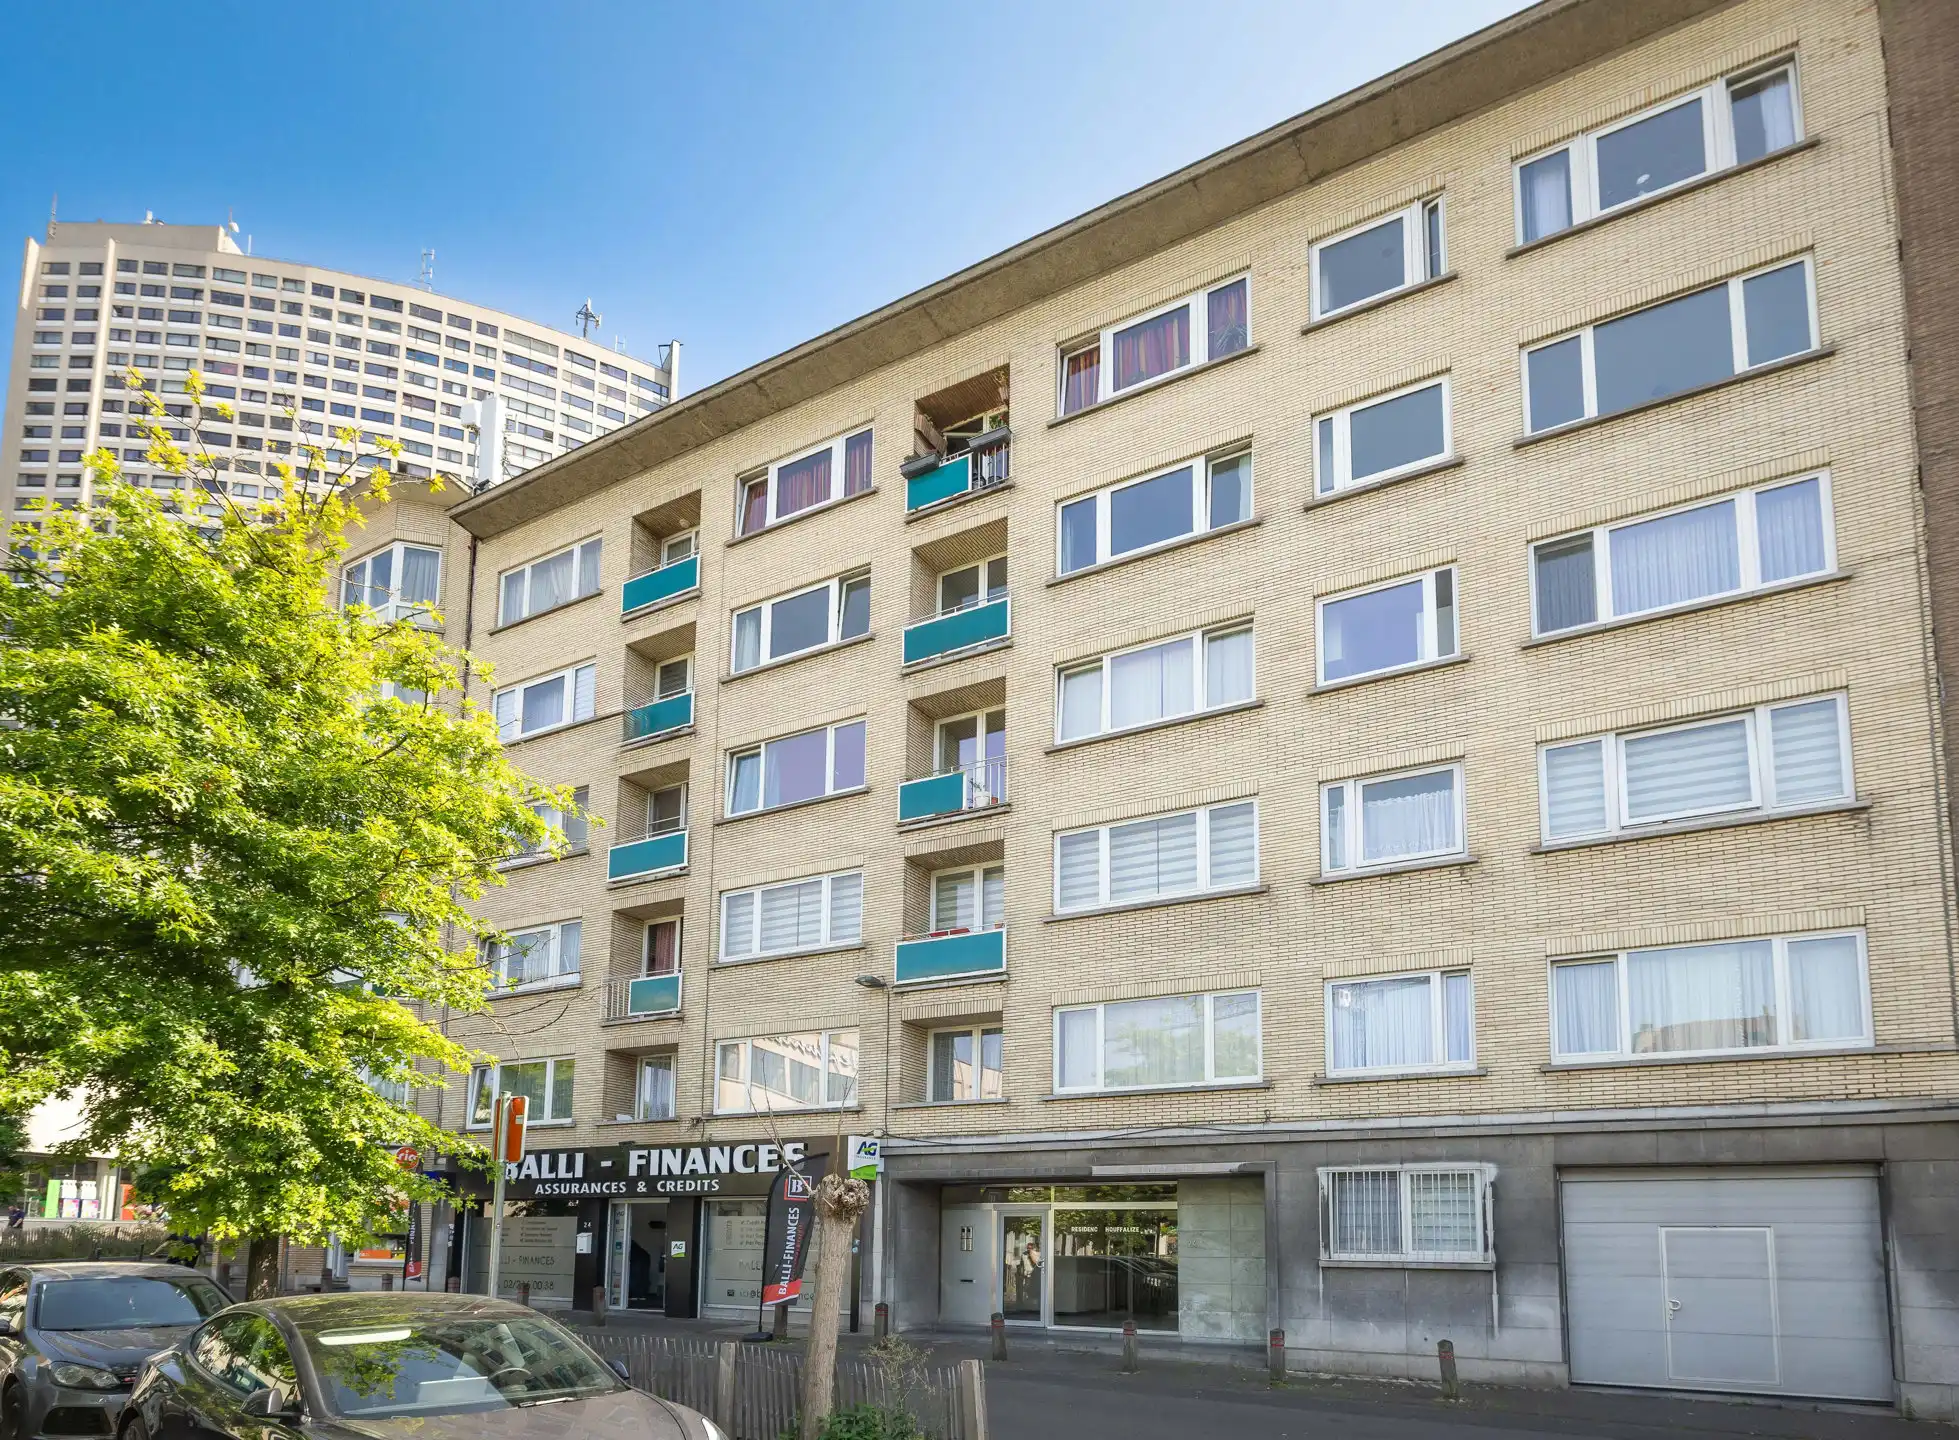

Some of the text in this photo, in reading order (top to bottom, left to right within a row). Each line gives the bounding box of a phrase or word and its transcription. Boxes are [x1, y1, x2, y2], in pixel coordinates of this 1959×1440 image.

[857, 1141, 878, 1156] AG
[628, 1143, 804, 1176] FINANCES
[535, 1179, 720, 1195] ASSURANCES & CREDITS
[583, 1221, 592, 1229] 24
[778, 1207, 800, 1295] BALLI-FINANCES
